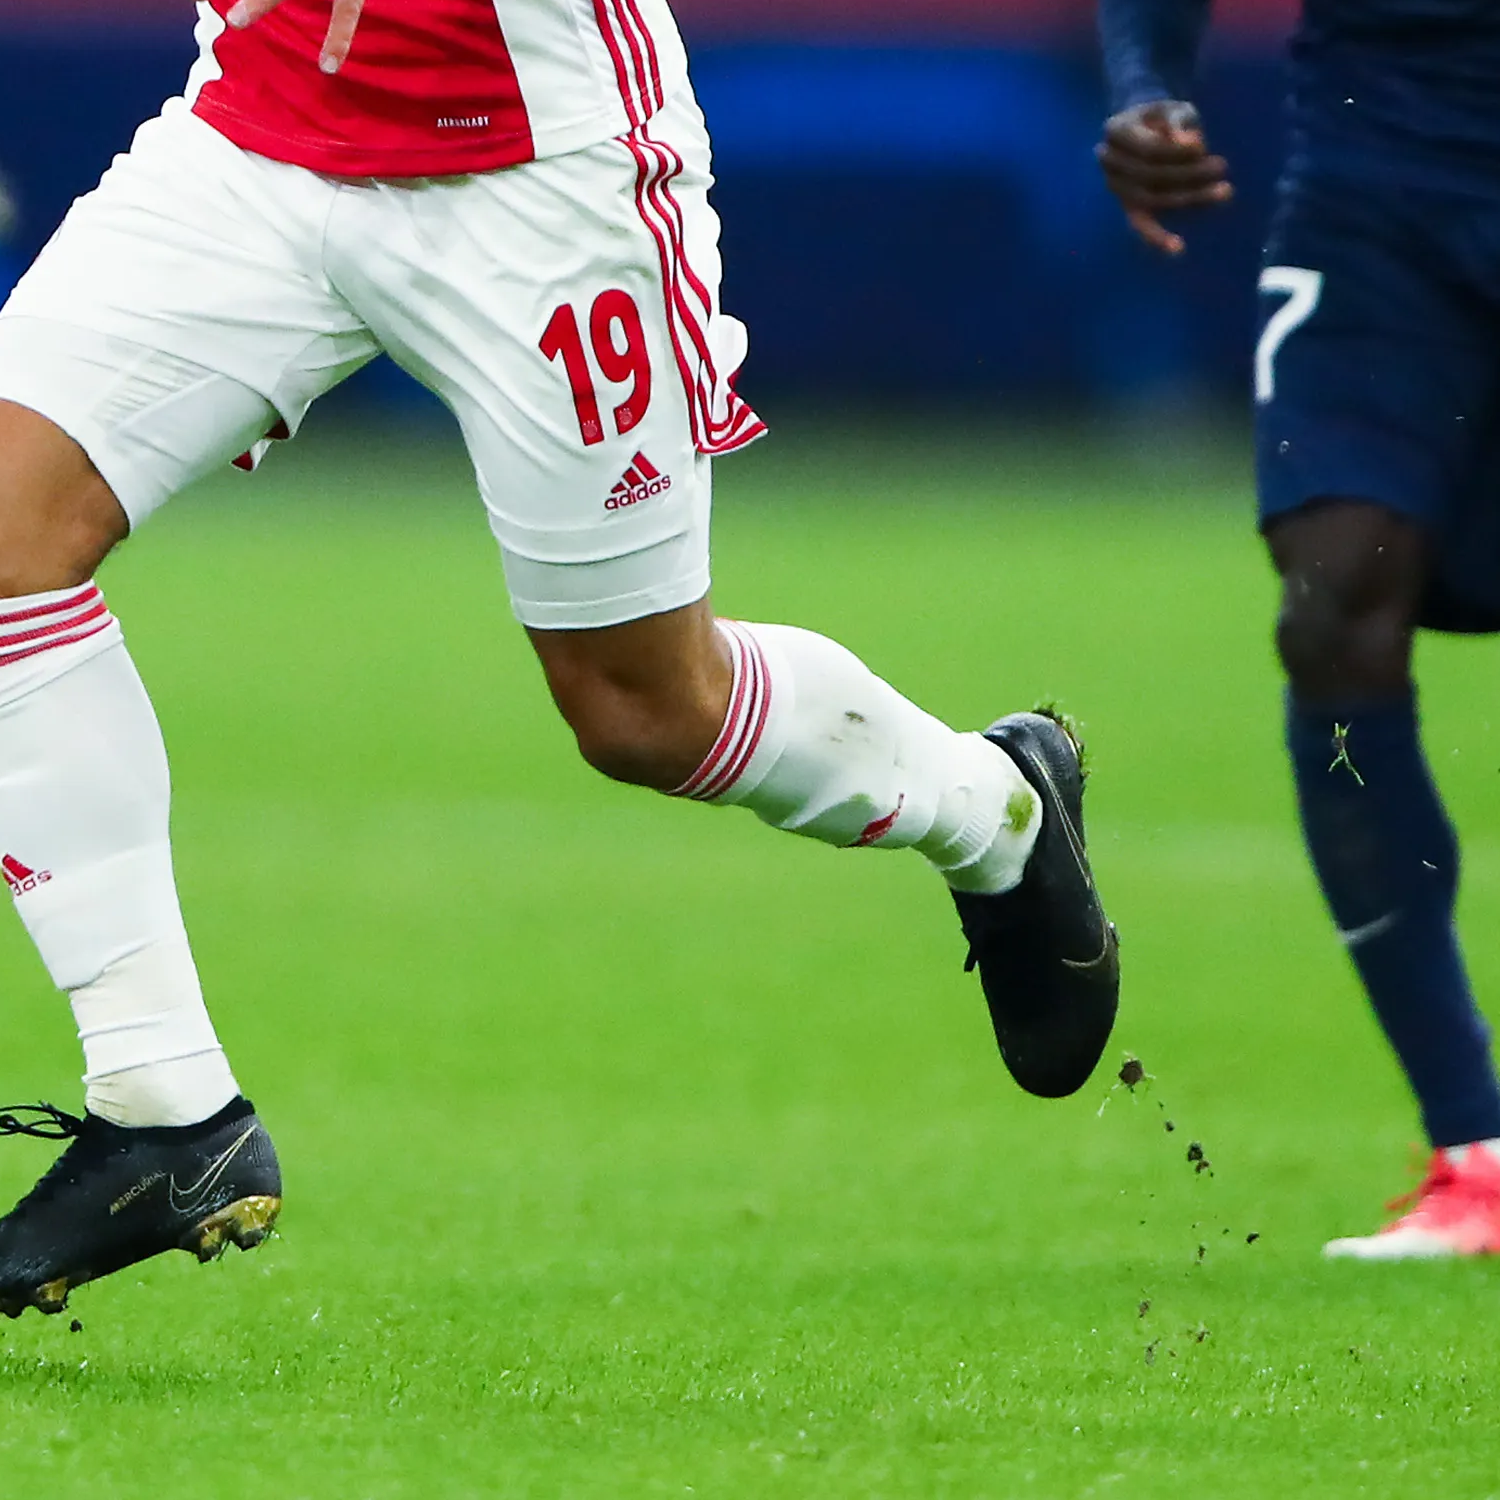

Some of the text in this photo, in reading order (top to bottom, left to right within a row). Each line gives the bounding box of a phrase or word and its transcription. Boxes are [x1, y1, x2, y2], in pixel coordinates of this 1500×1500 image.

[539, 289, 652, 447] 19
[1255, 265, 1324, 403] 7
[604, 475, 672, 510] adidas
